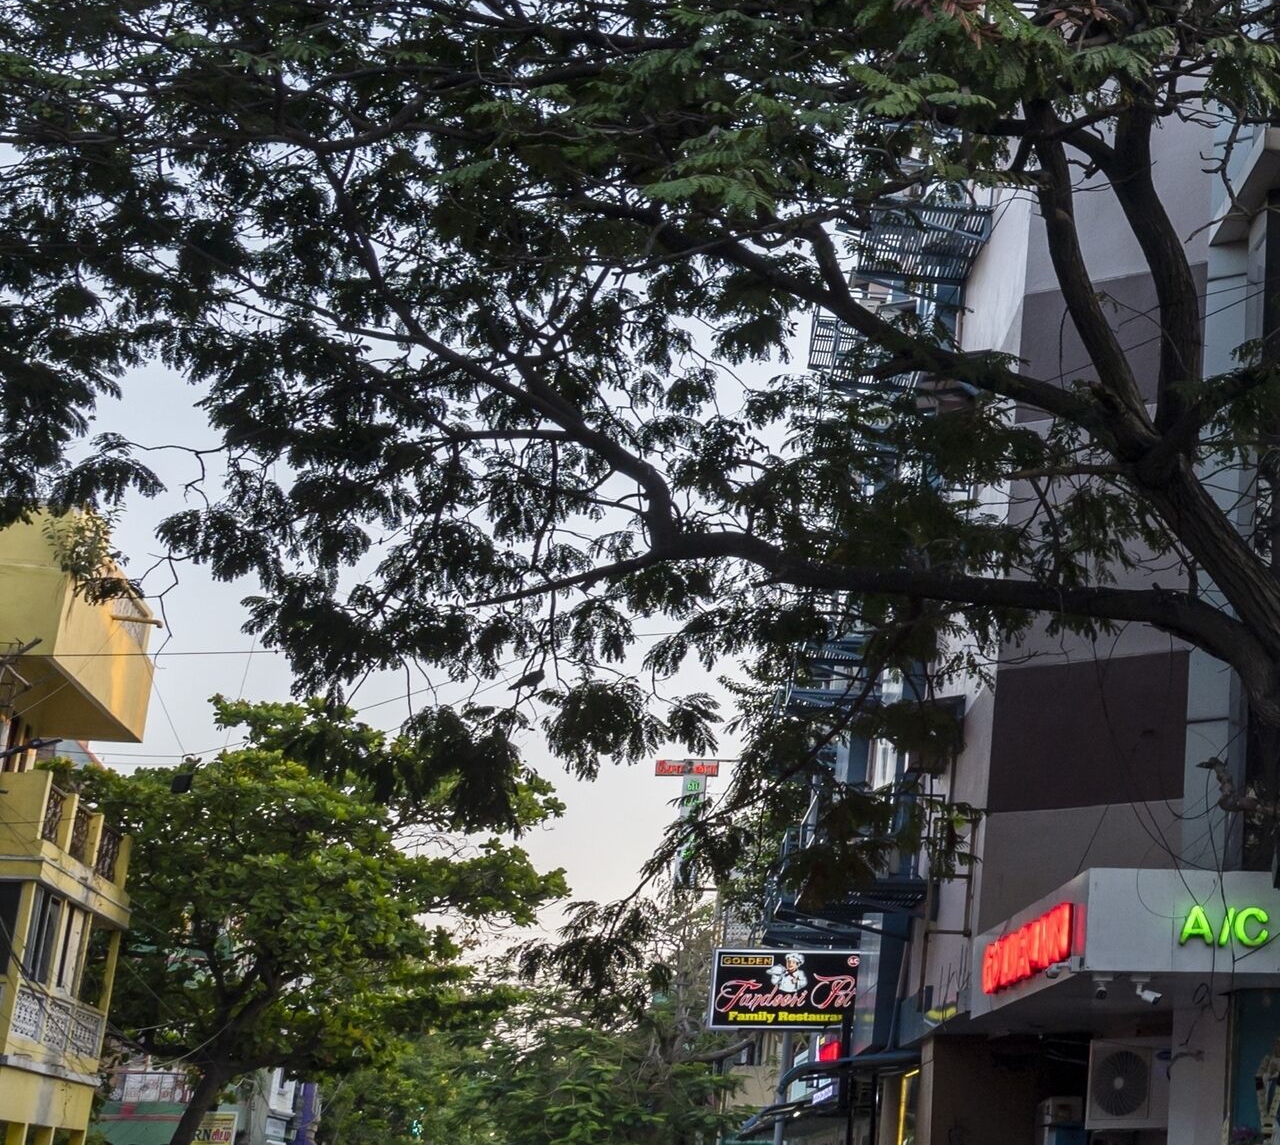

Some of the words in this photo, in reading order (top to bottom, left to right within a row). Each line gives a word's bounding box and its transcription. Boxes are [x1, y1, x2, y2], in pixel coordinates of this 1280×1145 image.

[1178, 904, 1269, 947] A/C
[722, 956, 773, 966] GOLDEN
[728, 1011, 776, 1023] Family
